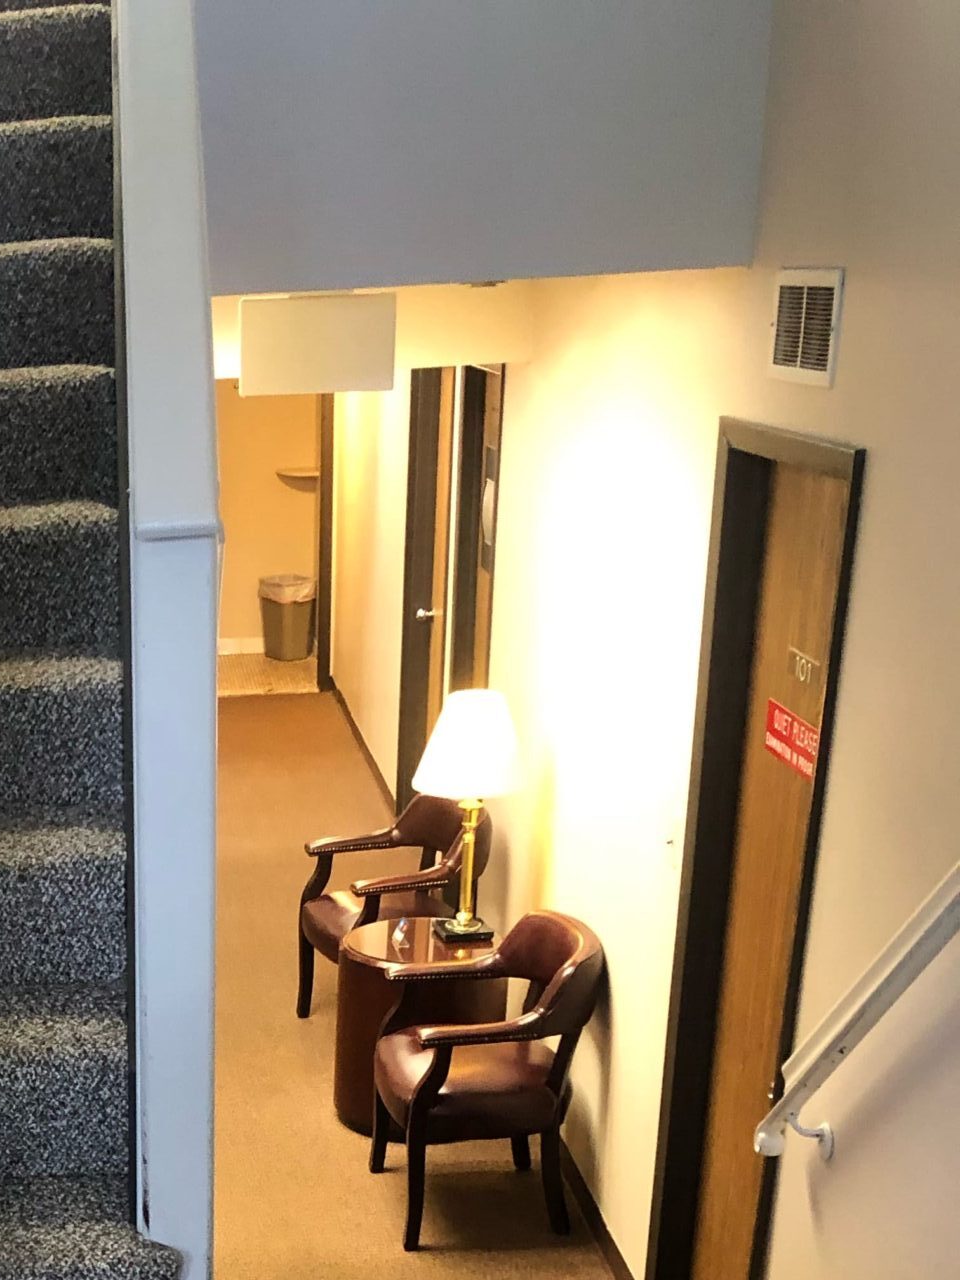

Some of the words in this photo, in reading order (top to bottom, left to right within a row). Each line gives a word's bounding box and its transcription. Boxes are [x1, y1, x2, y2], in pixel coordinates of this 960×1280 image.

[795, 656, 812, 684] 101
[774, 709, 792, 737] QUIET
[792, 720, 818, 755] PLEASE
